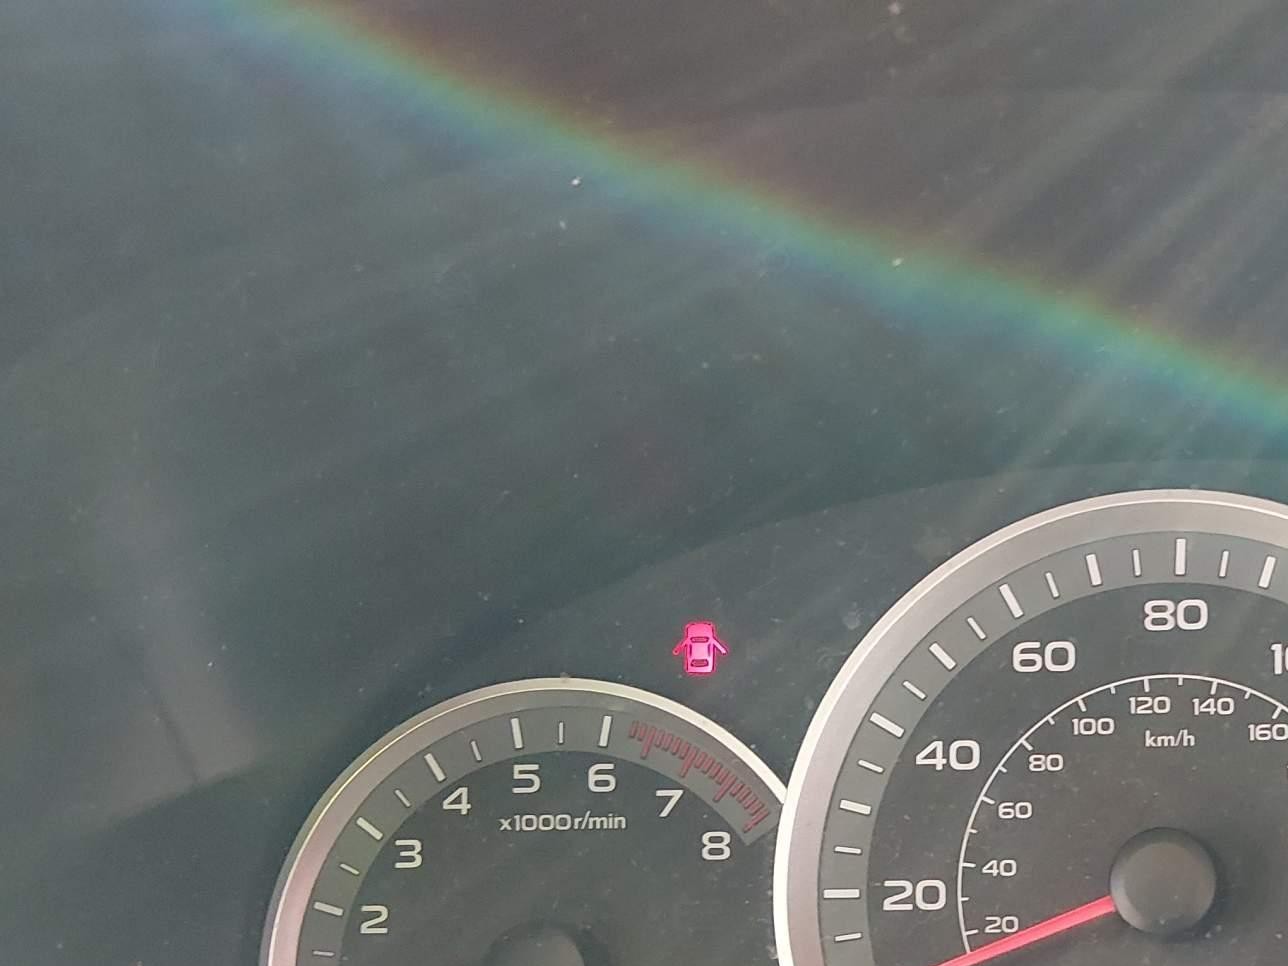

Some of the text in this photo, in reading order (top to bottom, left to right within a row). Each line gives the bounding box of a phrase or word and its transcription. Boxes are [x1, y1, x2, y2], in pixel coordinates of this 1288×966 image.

[1144, 600, 1208, 630] 80
[1013, 642, 1075, 672] 60
[1129, 697, 1170, 714] 120
[1193, 698, 1234, 715] 140
[1072, 718, 1114, 735] 100
[1146, 730, 1195, 746] km/h
[1248, 724, 1288, 740] 160
[916, 740, 980, 770] 40
[1029, 754, 1063, 771] 80
[512, 764, 540, 793] 5
[588, 764, 615, 792] 6
[443, 787, 471, 814] 4
[656, 790, 683, 817] 7
[999, 802, 1032, 818] 60
[395, 840, 422, 868] 3
[702, 832, 730, 860] 8
[982, 860, 1016, 876] 40
[883, 880, 946, 910] 20
[360, 906, 388, 933] 2
[985, 916, 1019, 933] 20
